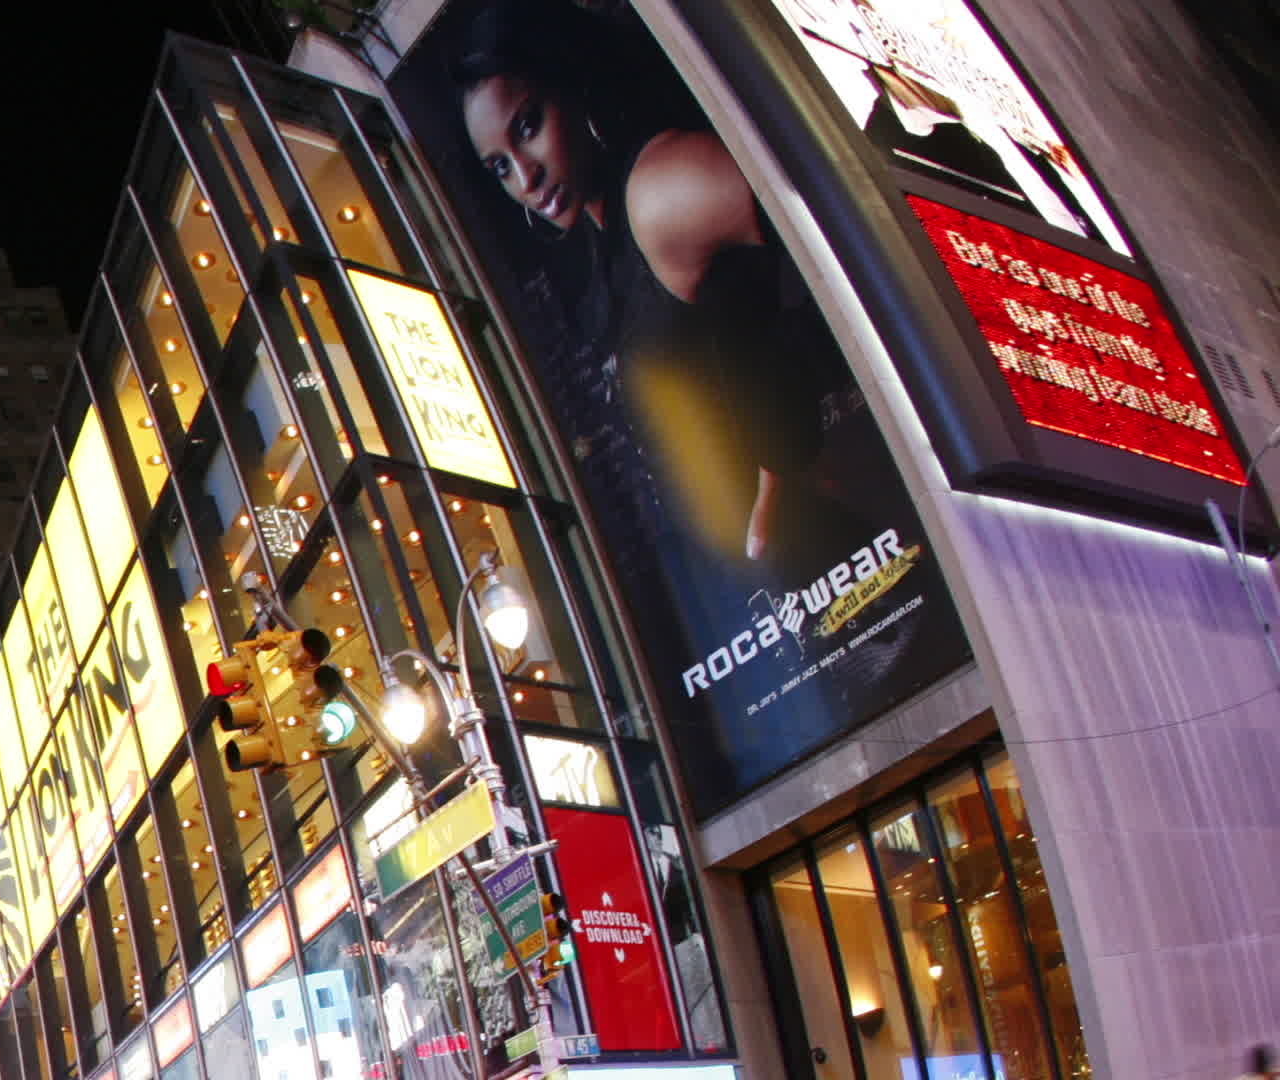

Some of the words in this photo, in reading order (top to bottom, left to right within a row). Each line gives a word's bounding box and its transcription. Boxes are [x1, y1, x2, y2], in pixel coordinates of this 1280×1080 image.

[384, 312, 439, 345] THE
[391, 342, 463, 388] LION
[411, 394, 487, 442] KING
[66, 602, 151, 811] KING
[581, 909, 631, 927] DISCOVER
[586, 927, 644, 945] DOWNLOAD
[576, 1039, 589, 1055] 45
